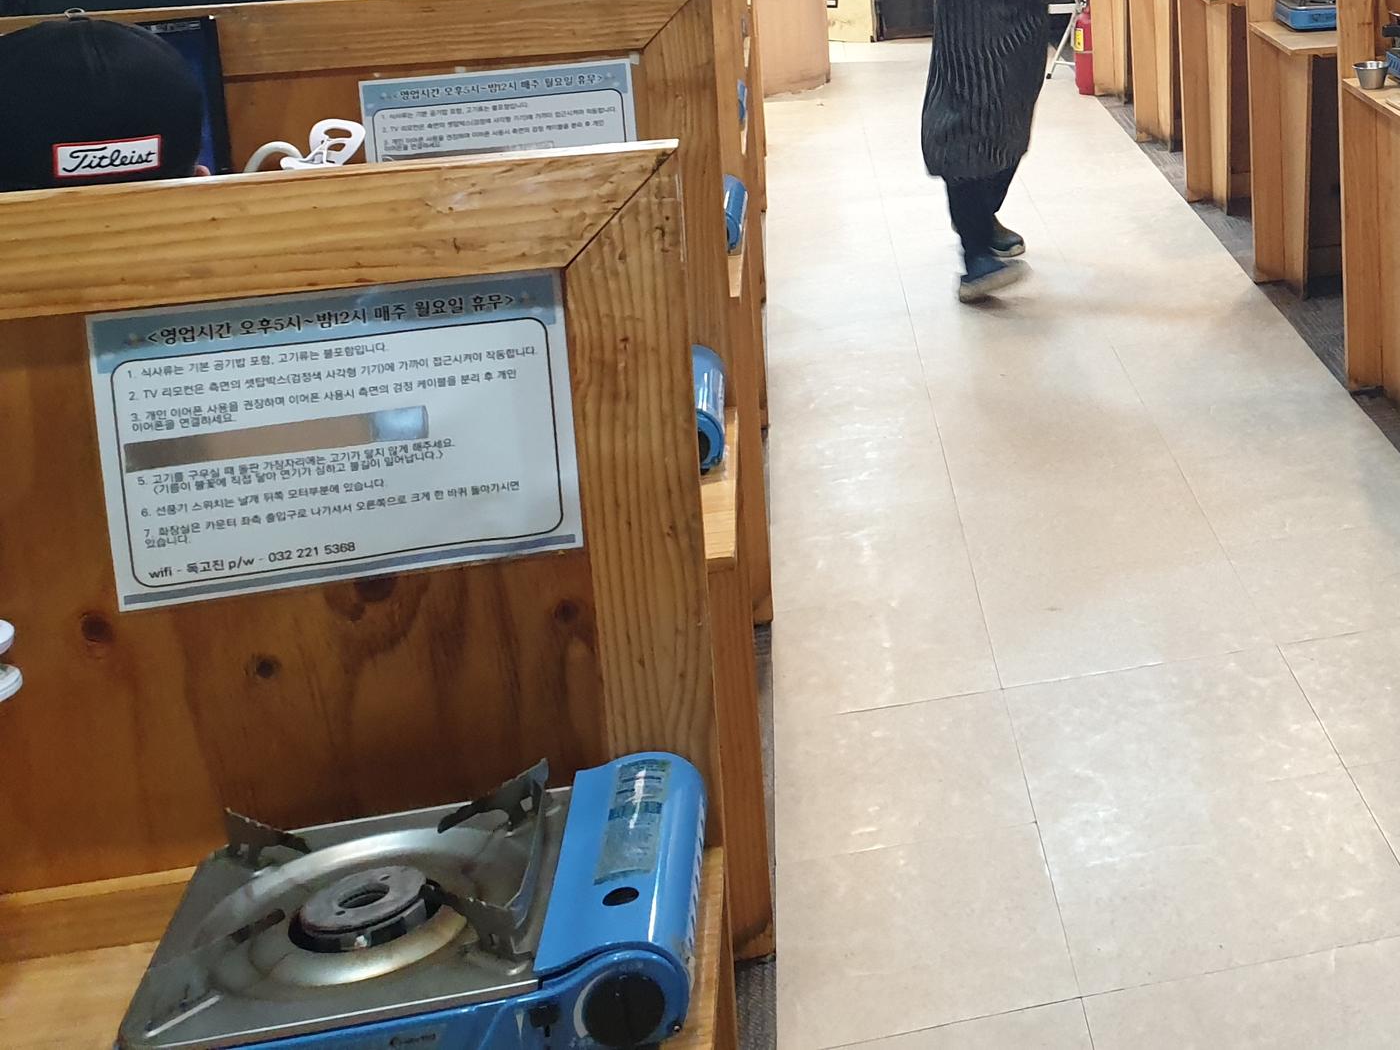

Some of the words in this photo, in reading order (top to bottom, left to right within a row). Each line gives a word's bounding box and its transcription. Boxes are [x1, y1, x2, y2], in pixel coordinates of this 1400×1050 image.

[62, 146, 157, 172] Titleist
[146, 321, 231, 346] <영업시간
[373, 303, 407, 323] 매주
[414, 297, 463, 319] 월요일
[471, 292, 514, 313] 휴무>
[140, 364, 184, 378] 식사류는
[188, 361, 209, 373] 기본
[213, 357, 246, 371] 공기밥
[277, 350, 319, 364] 고기류는
[142, 388, 158, 400] TV
[161, 382, 205, 398] 리모컨은
[208, 379, 241, 393] 측면의
[325, 366, 356, 380] 사각형
[145, 408, 167, 422] 개인
[169, 404, 203, 419] 이어폰
[206, 400, 238, 415] 사용을
[243, 395, 285, 410] 권장하며
[288, 391, 320, 405] 이어폰
[323, 387, 354, 401] 사용시
[358, 383, 389, 397] 측면의
[393, 381, 412, 393] 검정
[460, 373, 480, 386] 분리
[496, 369, 516, 381] 개인
[131, 419, 175, 434] 이어폰을
[223, 465, 234, 476] 때
[328, 449, 360, 463] 고기가
[230, 473, 253, 487] 직접
[279, 466, 311, 480] 연기가
[315, 461, 345, 476] 심하고
[204, 516, 236, 531] 카운터
[240, 513, 261, 527] 좌측
[410, 491, 430, 504] 크게
[148, 565, 172, 579] wifi
[186, 558, 224, 575] 독고진
[227, 553, 254, 569] p/w
[267, 549, 292, 562] 032
[295, 545, 318, 558] 221
